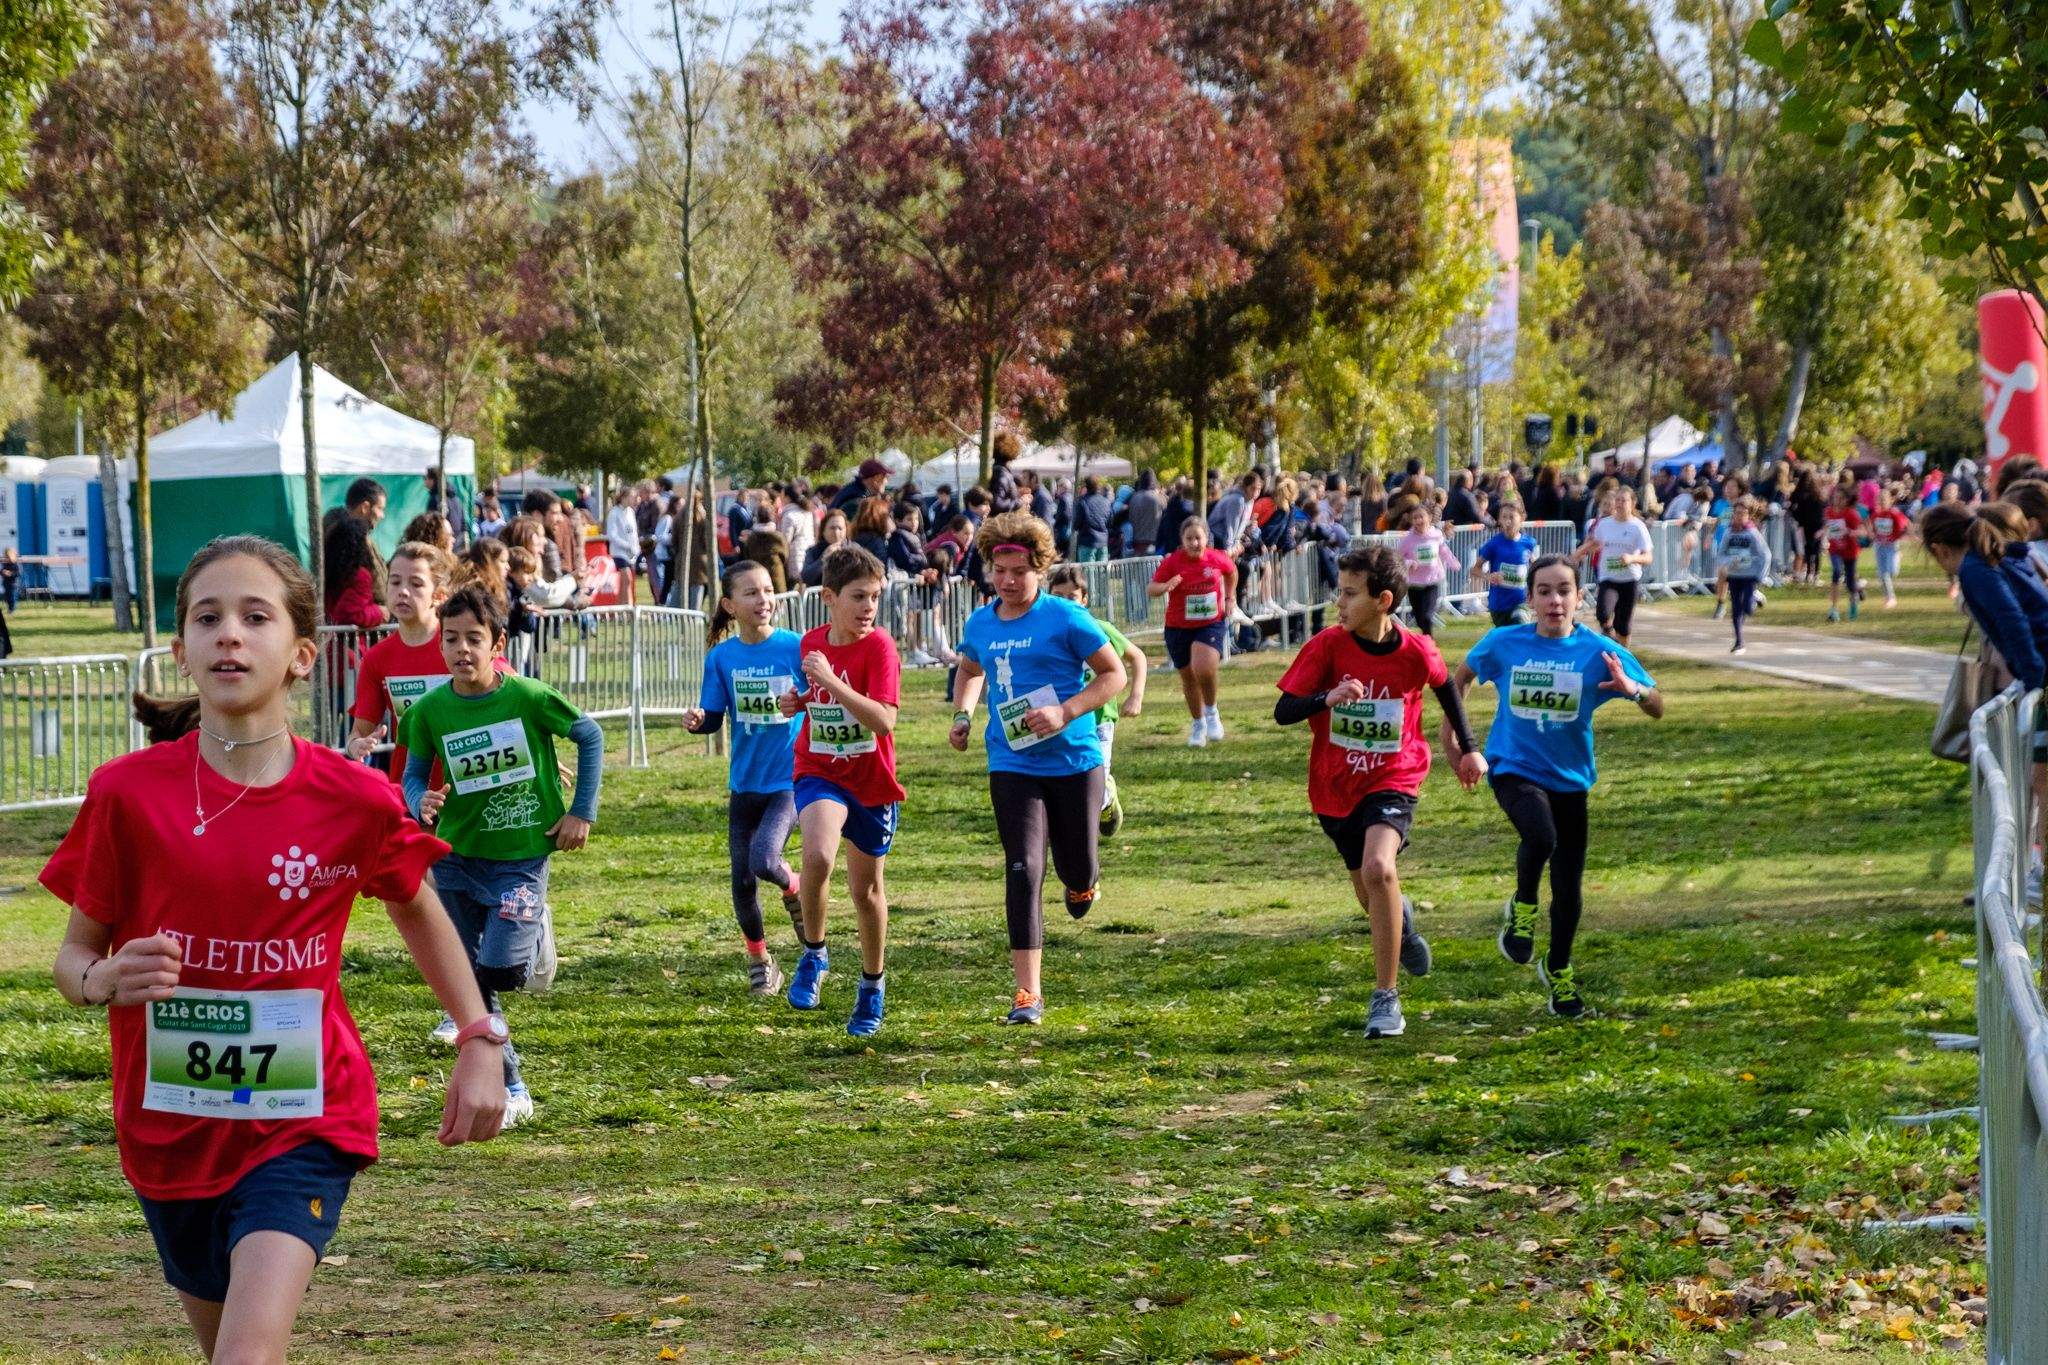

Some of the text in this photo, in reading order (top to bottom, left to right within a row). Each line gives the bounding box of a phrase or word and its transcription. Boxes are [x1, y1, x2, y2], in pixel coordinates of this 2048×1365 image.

[403, 681, 424, 690] CROS
[1519, 688, 1570, 708] 1467
[821, 709, 841, 717] CROS
[819, 723, 863, 741] 1931
[1010, 717, 1032, 736] 14
[1340, 718, 1391, 739] 1938
[464, 733, 489, 746] CROS
[460, 746, 518, 776] 2375
[311, 864, 357, 880] AMPA
[157, 1002, 190, 1018] 21è
[194, 1004, 246, 1021] CROS
[157, 1019, 246, 1031] Ciutat de Sant Cugat 2019
[186, 1040, 277, 1084] 847
